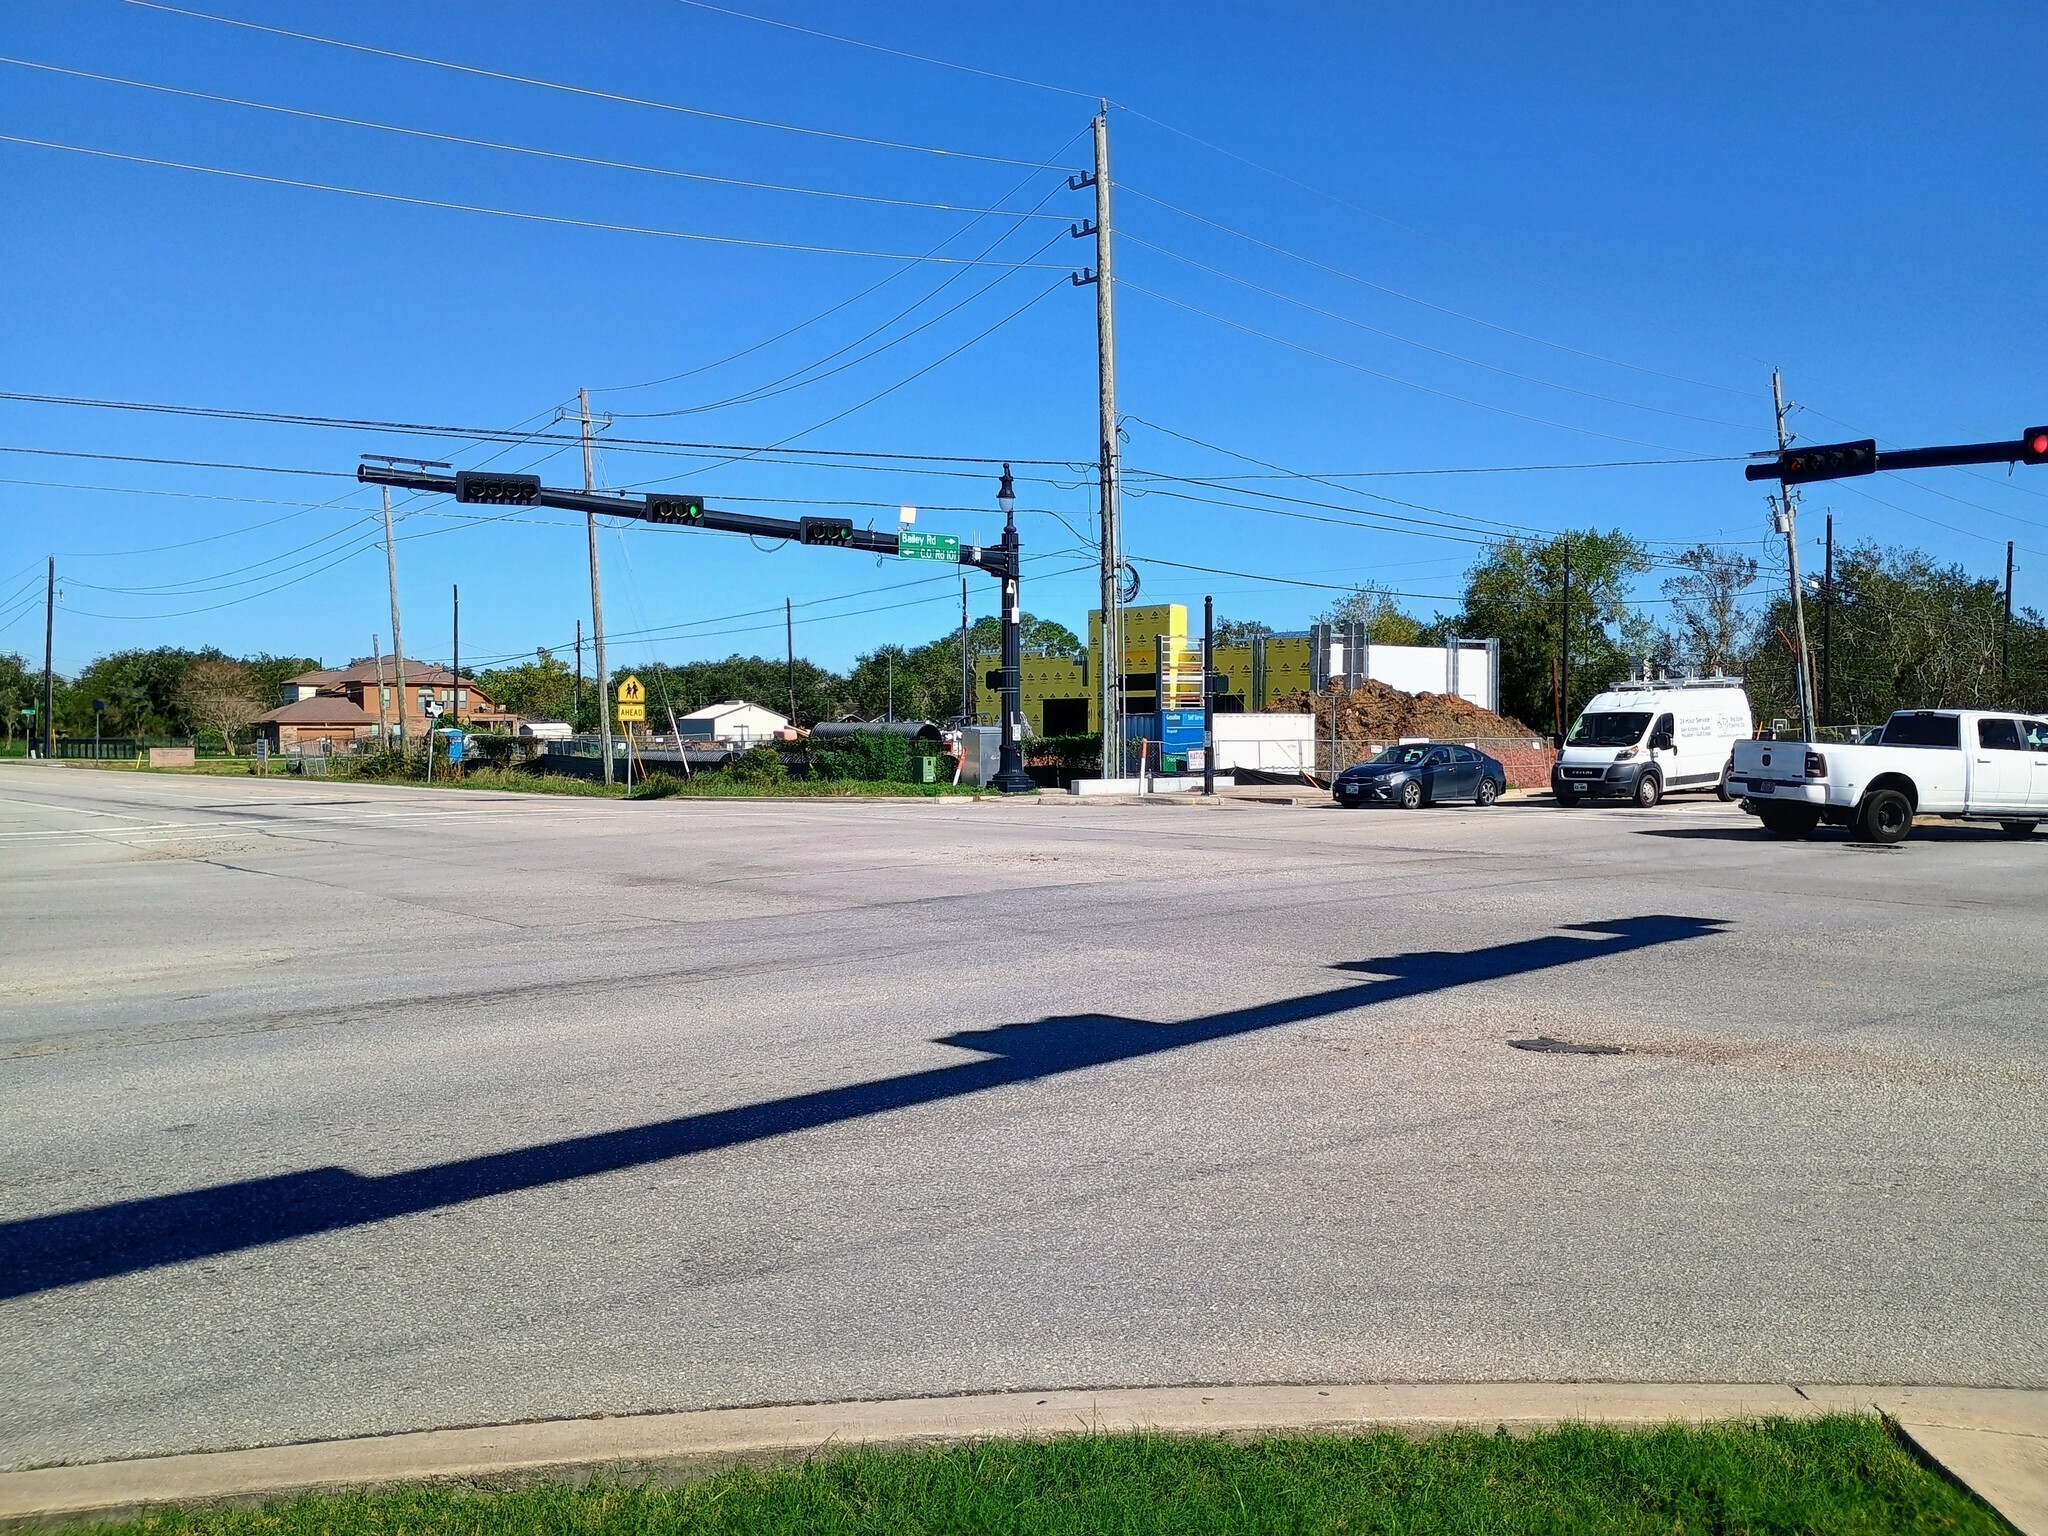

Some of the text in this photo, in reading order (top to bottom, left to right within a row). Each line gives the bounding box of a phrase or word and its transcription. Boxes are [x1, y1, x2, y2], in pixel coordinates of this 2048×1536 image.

[902, 533, 937, 546] Bailey Rd
[935, 549, 945, 560] Rd
[946, 550, 957, 560] 101
